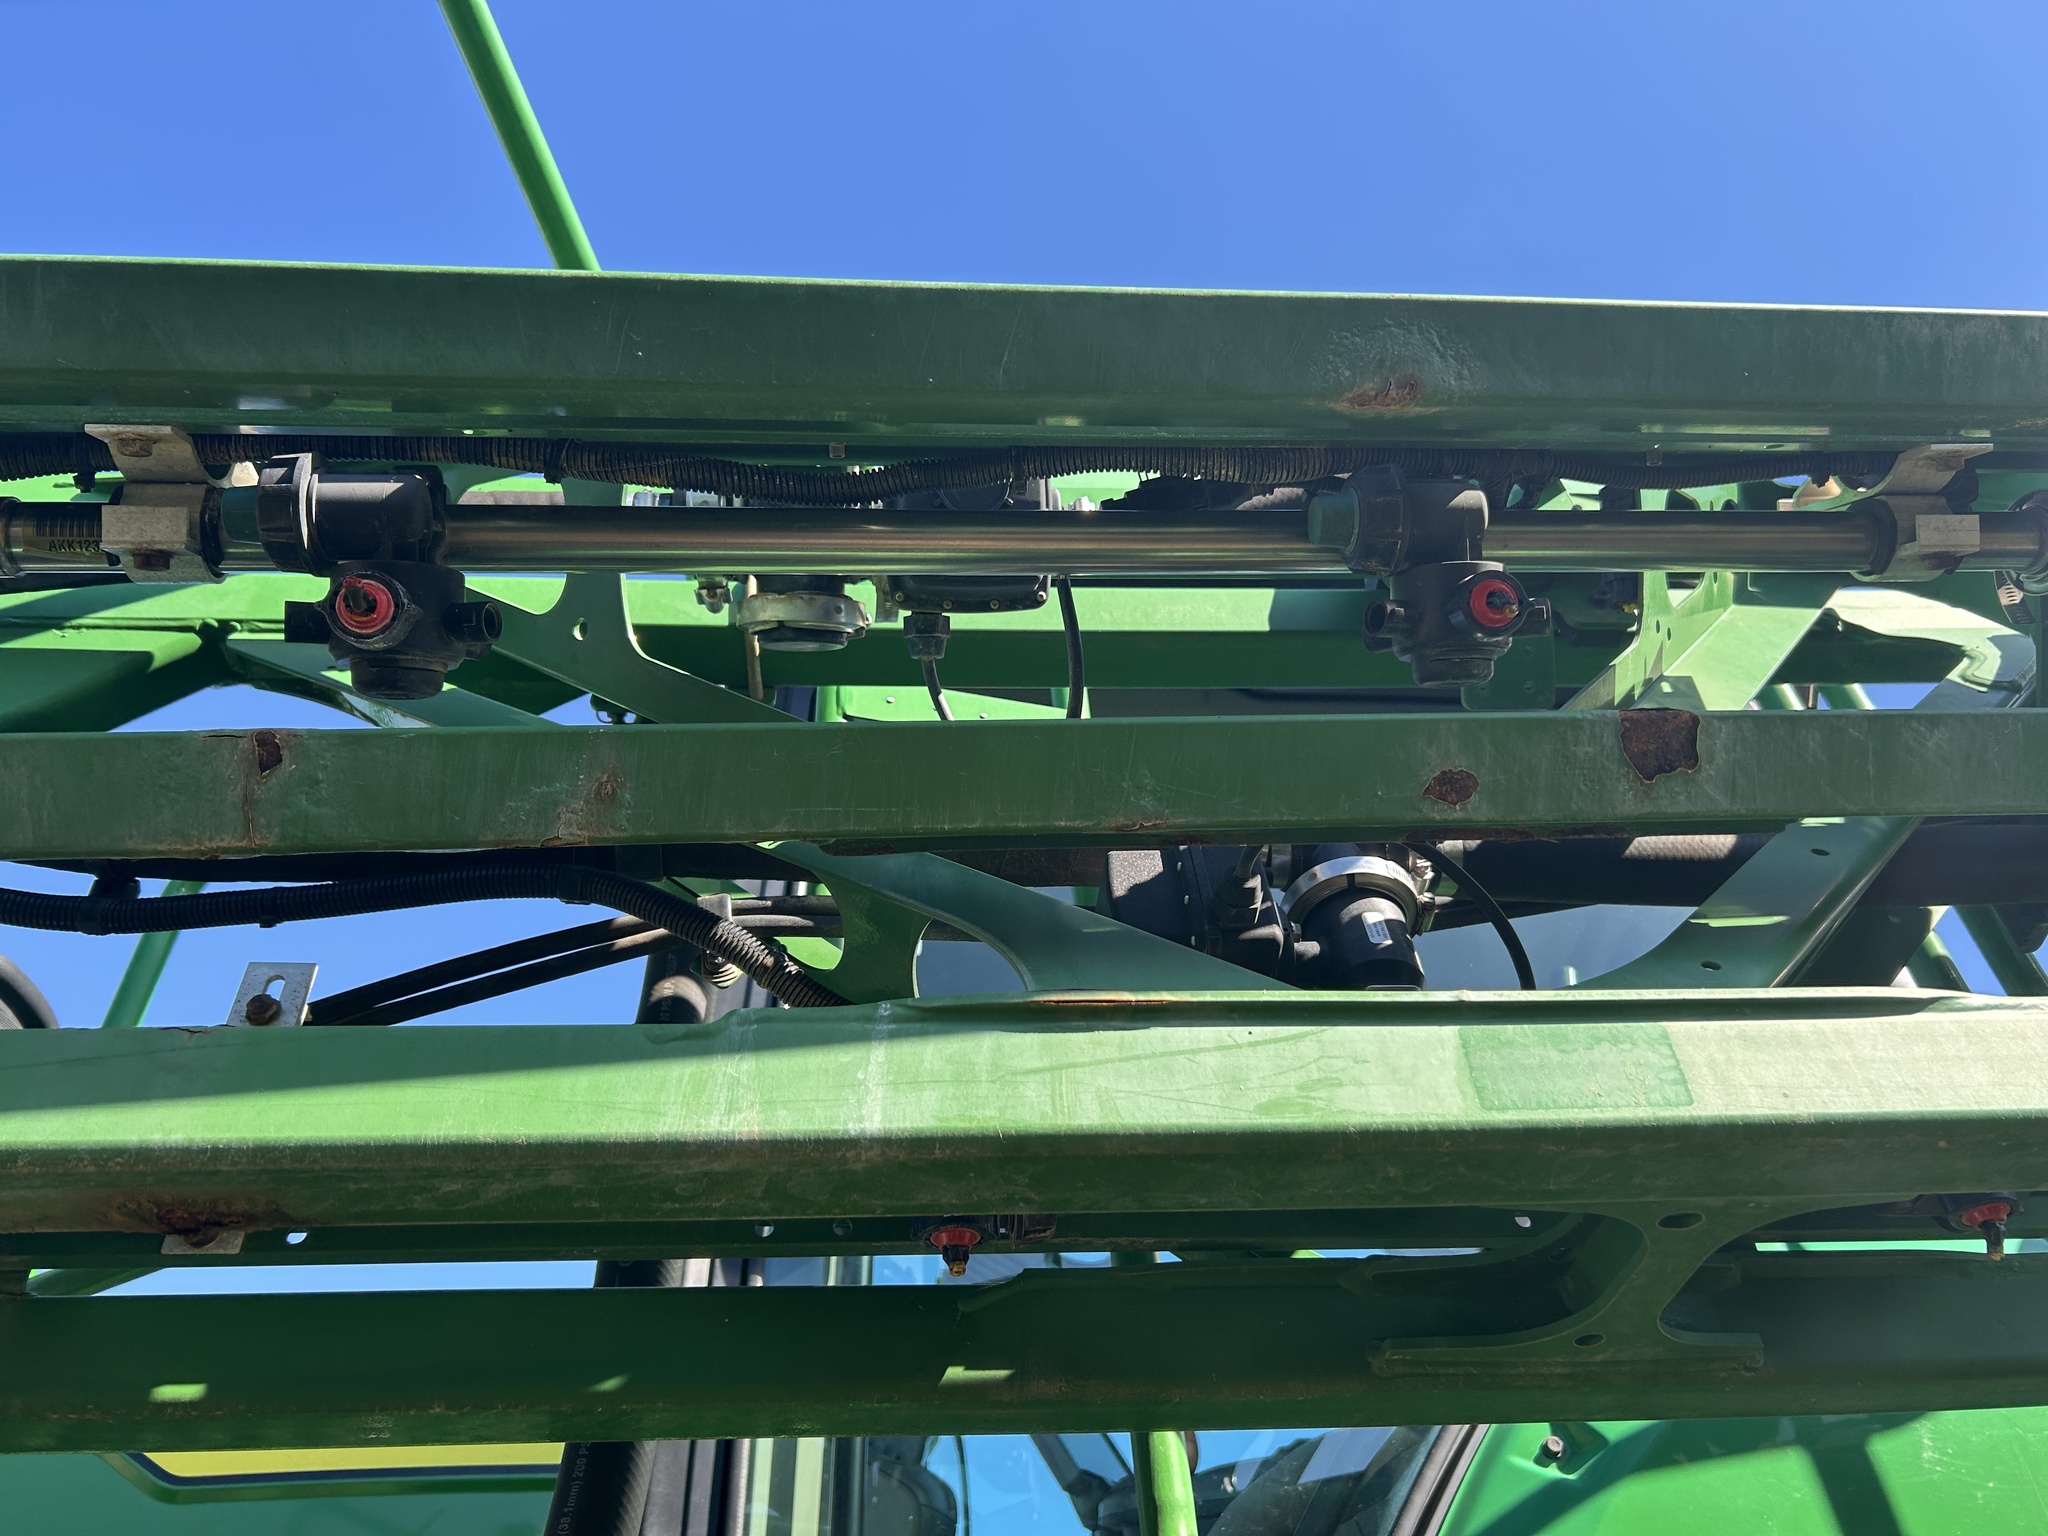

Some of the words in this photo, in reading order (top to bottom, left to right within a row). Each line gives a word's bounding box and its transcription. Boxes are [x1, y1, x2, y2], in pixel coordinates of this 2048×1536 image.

[48, 539, 103, 552] AKK123
[557, 1480, 584, 1535] (38.1mm)
[573, 1458, 586, 1477] 200
